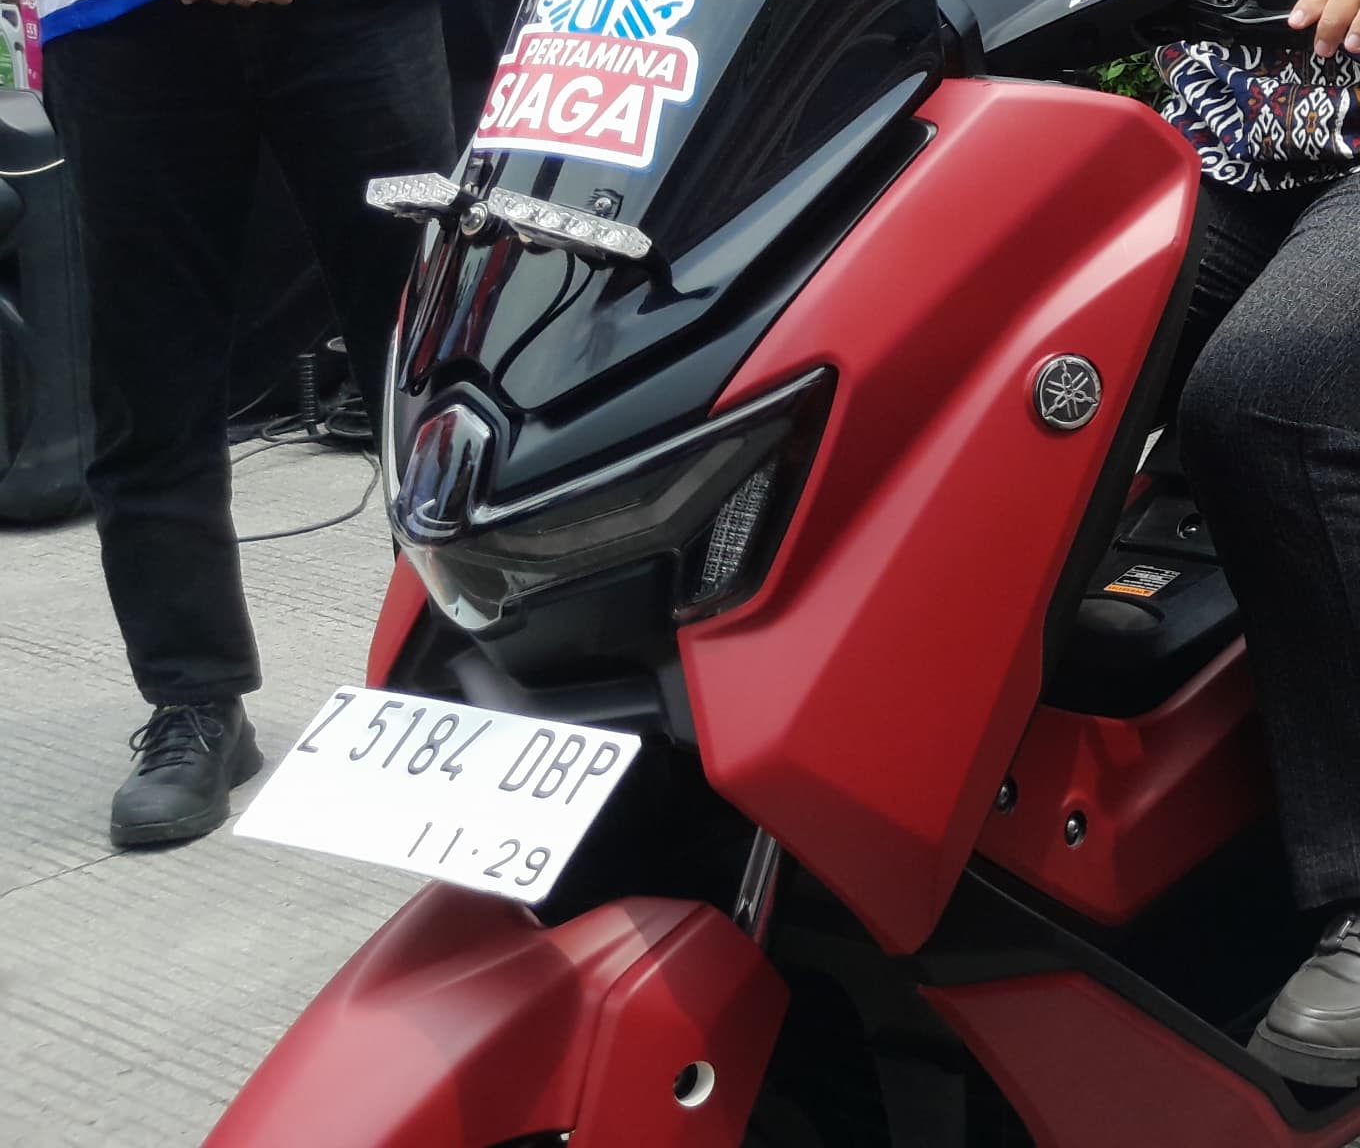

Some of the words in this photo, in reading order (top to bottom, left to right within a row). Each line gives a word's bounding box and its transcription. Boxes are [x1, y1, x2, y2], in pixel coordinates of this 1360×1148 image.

[521, 38, 678, 82] PERTAMINA
[480, 72, 646, 146] SIAGA
[297, 692, 357, 753] Z
[349, 700, 493, 782] 5184
[498, 727, 622, 805] DBP
